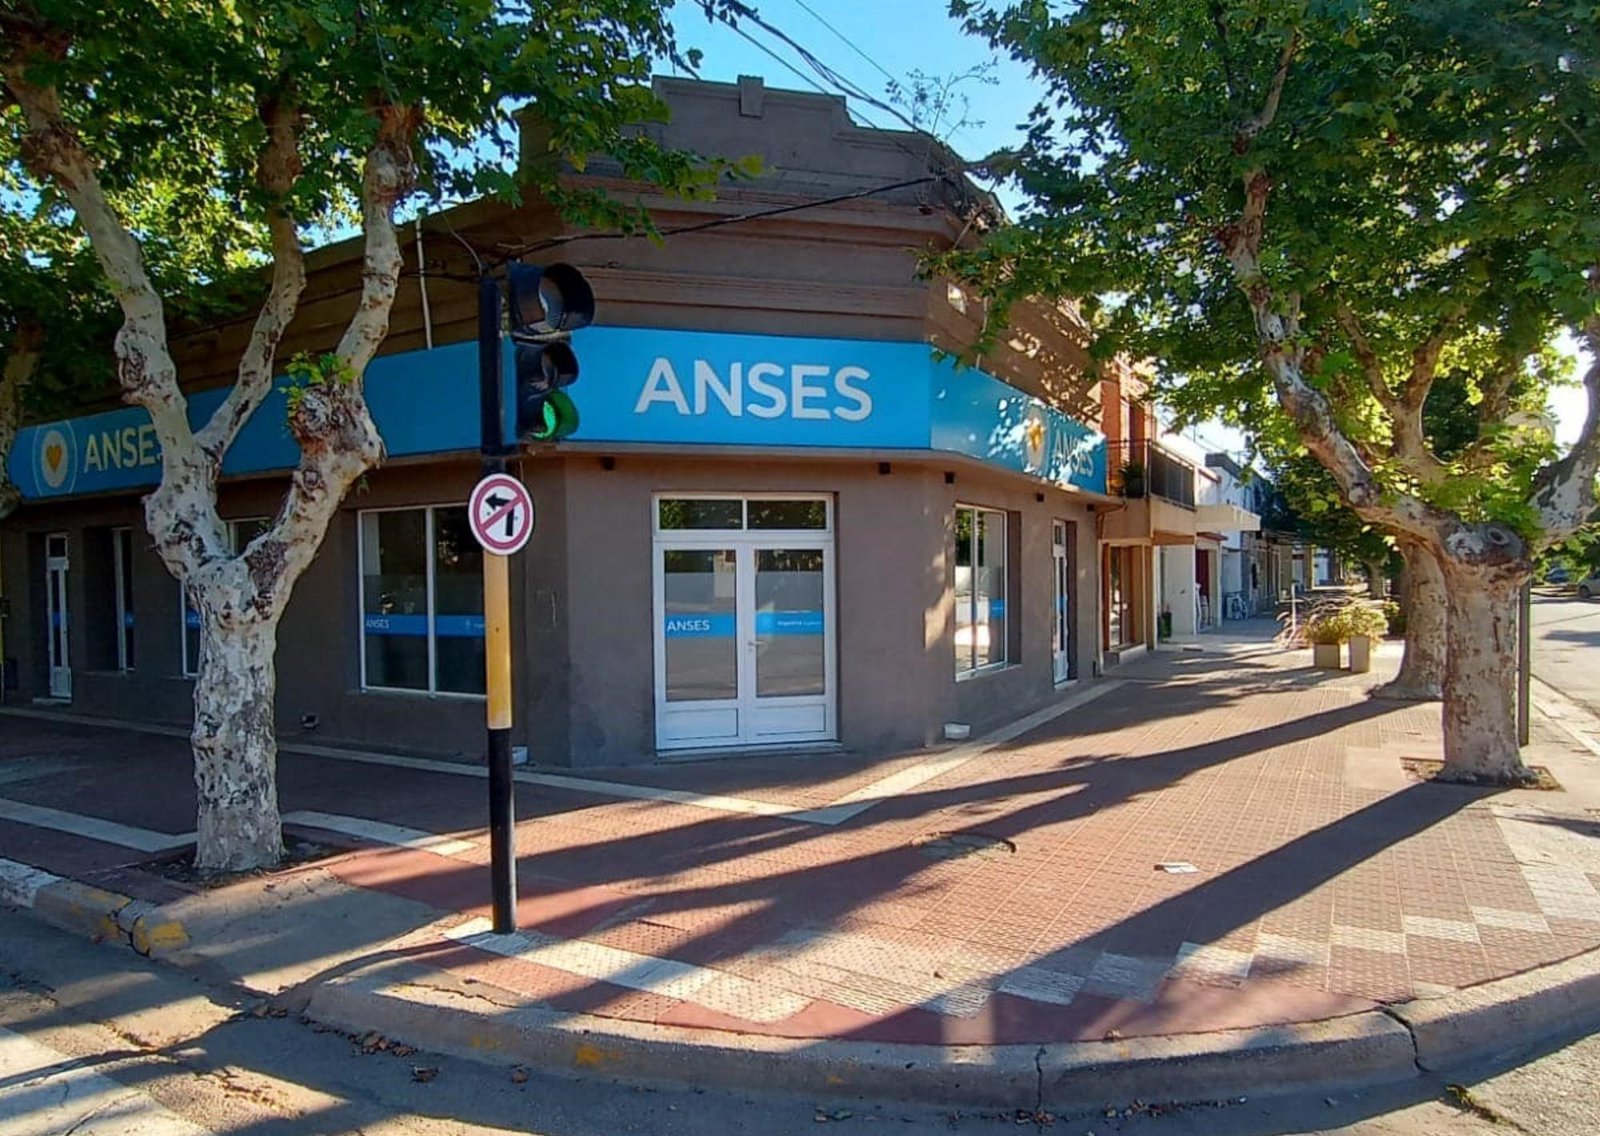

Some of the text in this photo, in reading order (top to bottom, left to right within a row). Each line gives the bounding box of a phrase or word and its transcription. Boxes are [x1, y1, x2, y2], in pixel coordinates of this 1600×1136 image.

[634, 357, 873, 421] ANSES
[83, 424, 160, 474] ANSE
[667, 619, 710, 632] ANSES
